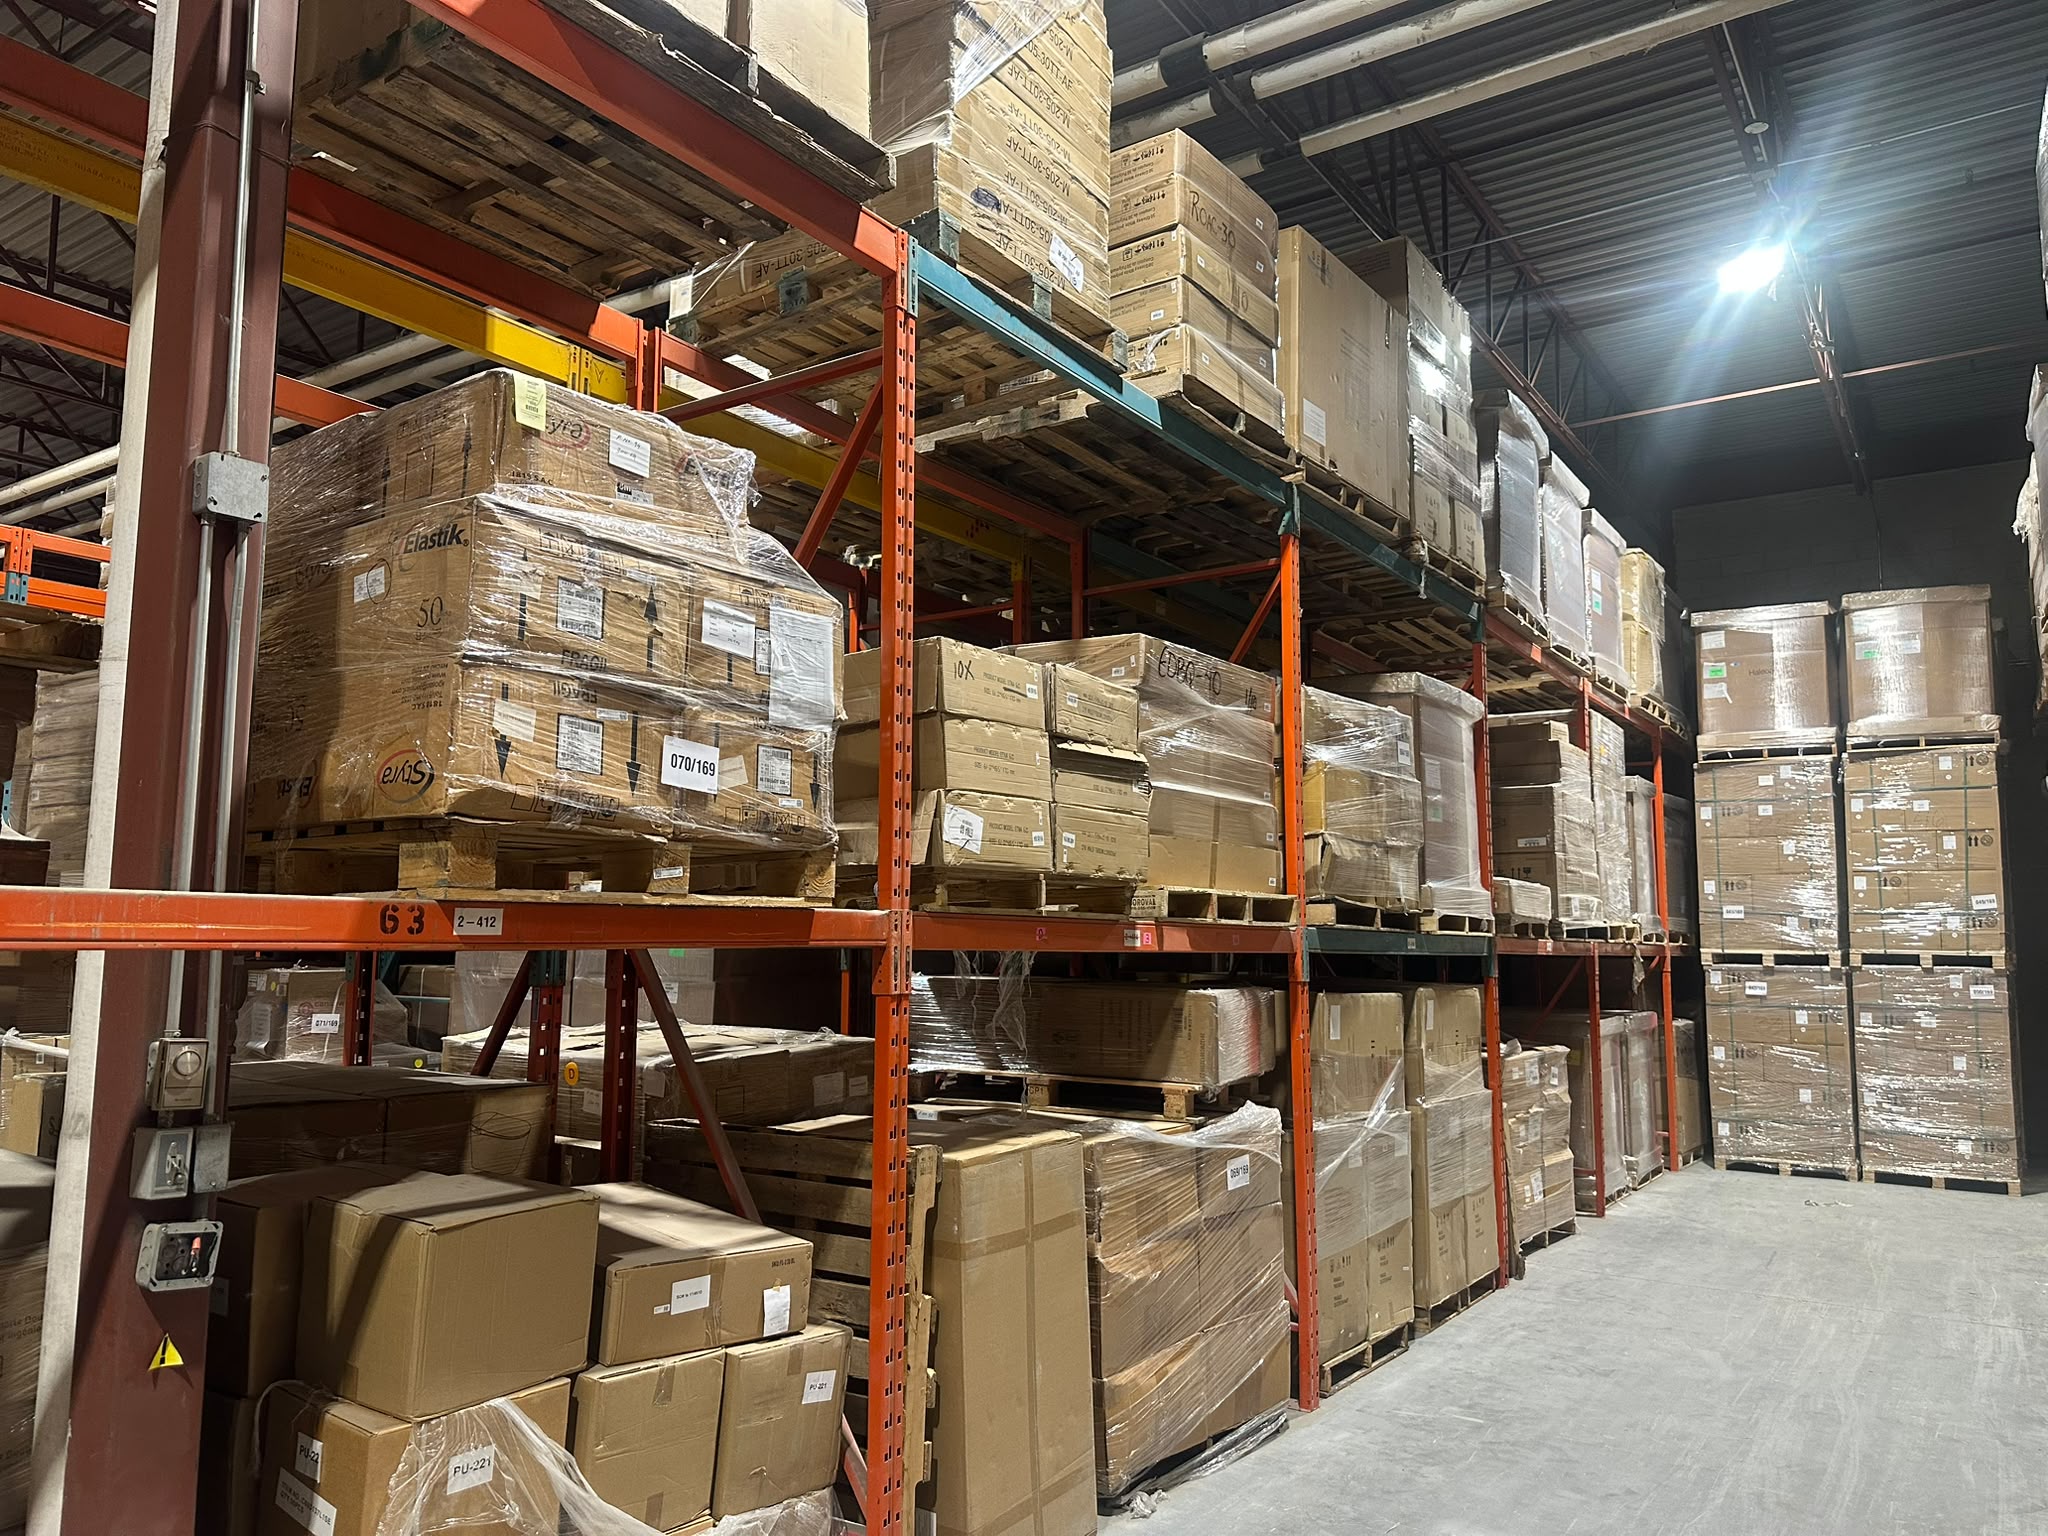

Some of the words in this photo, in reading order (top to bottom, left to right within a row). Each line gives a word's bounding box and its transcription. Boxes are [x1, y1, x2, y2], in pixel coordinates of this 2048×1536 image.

[1007, 64, 1071, 129] M-205-30TT-AF
[1005, 136, 1071, 197] M-205-30TT-AF
[403, 523, 466, 554] Elastik
[953, 660, 975, 681] 10X
[381, 759, 426, 785] Styra
[670, 753, 716, 777] 070/169
[453, 1455, 492, 1477] PU-221
